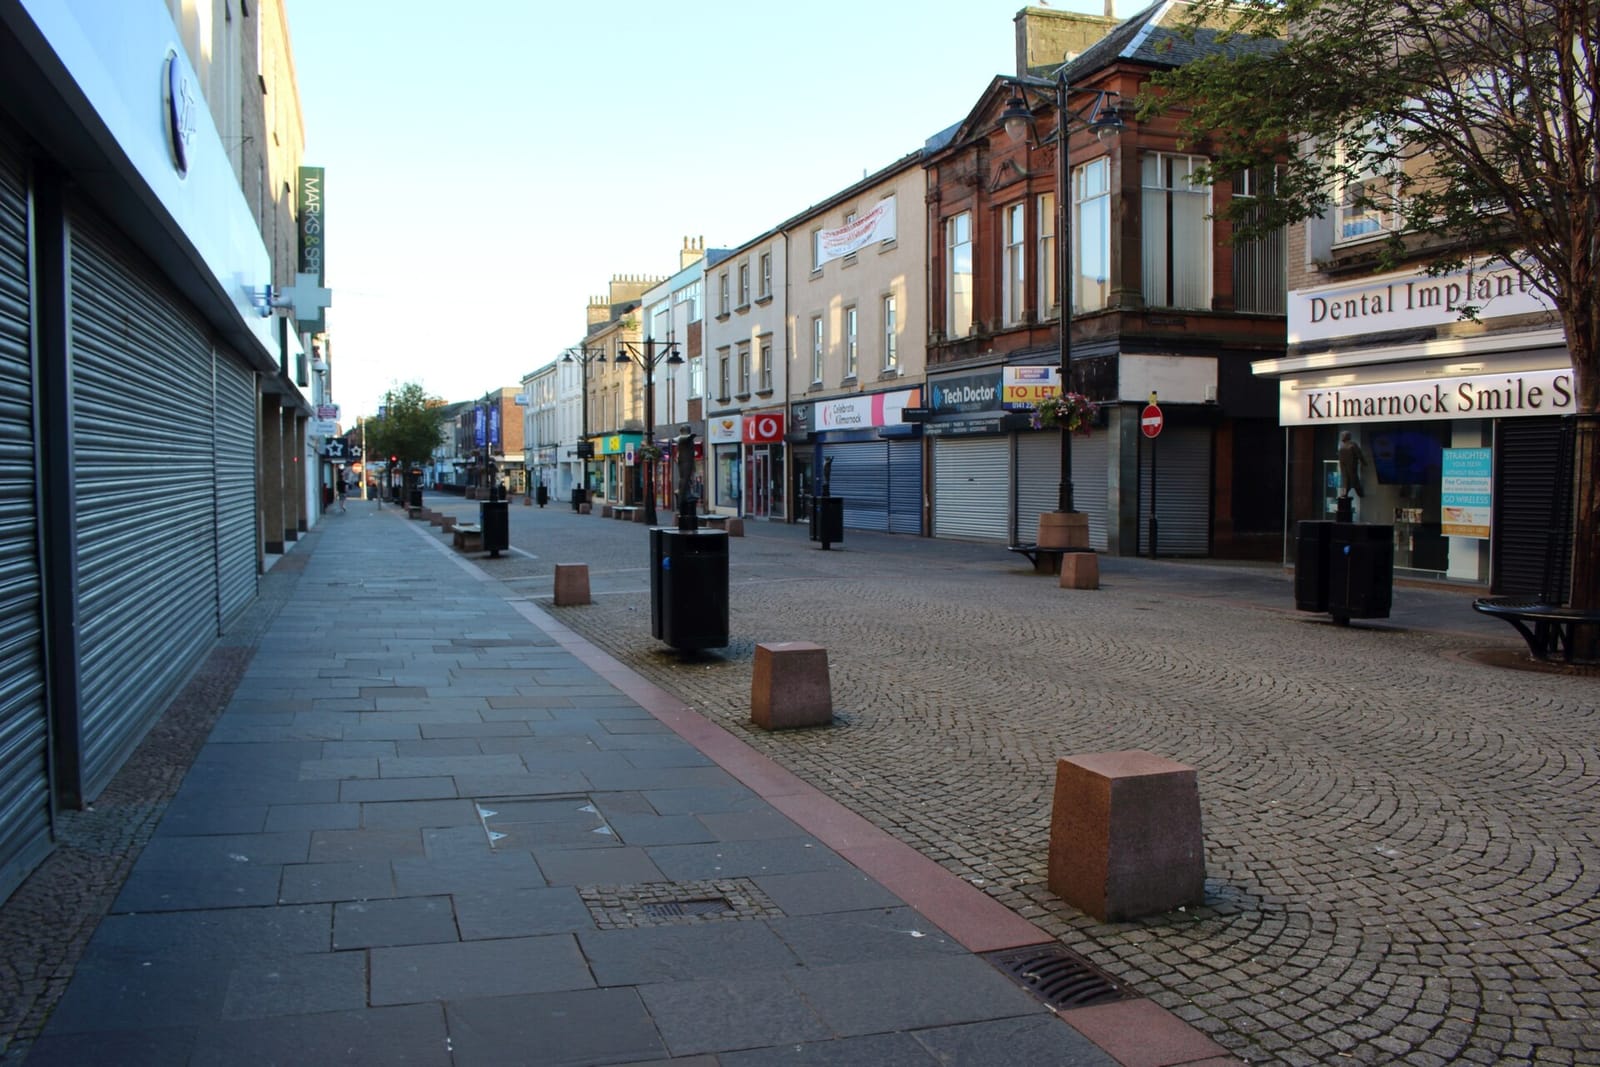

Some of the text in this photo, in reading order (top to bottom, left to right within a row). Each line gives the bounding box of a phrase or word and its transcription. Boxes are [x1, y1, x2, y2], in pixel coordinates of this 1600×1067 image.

[304, 177, 320, 234] MARKS
[305, 235, 320, 246] &
[1310, 268, 1530, 323] Dental Implant
[942, 385, 995, 405] Tech Doctor
[1008, 385, 1056, 398] TO LET
[1307, 375, 1572, 419] Kilmarnock Smile S
[833, 403, 855, 414] Celebrate
[835, 415, 861, 424] Kilmarnock
[1447, 452, 1489, 460] STRAIGHTEN
[1457, 496, 1489, 504] WIRELESS
